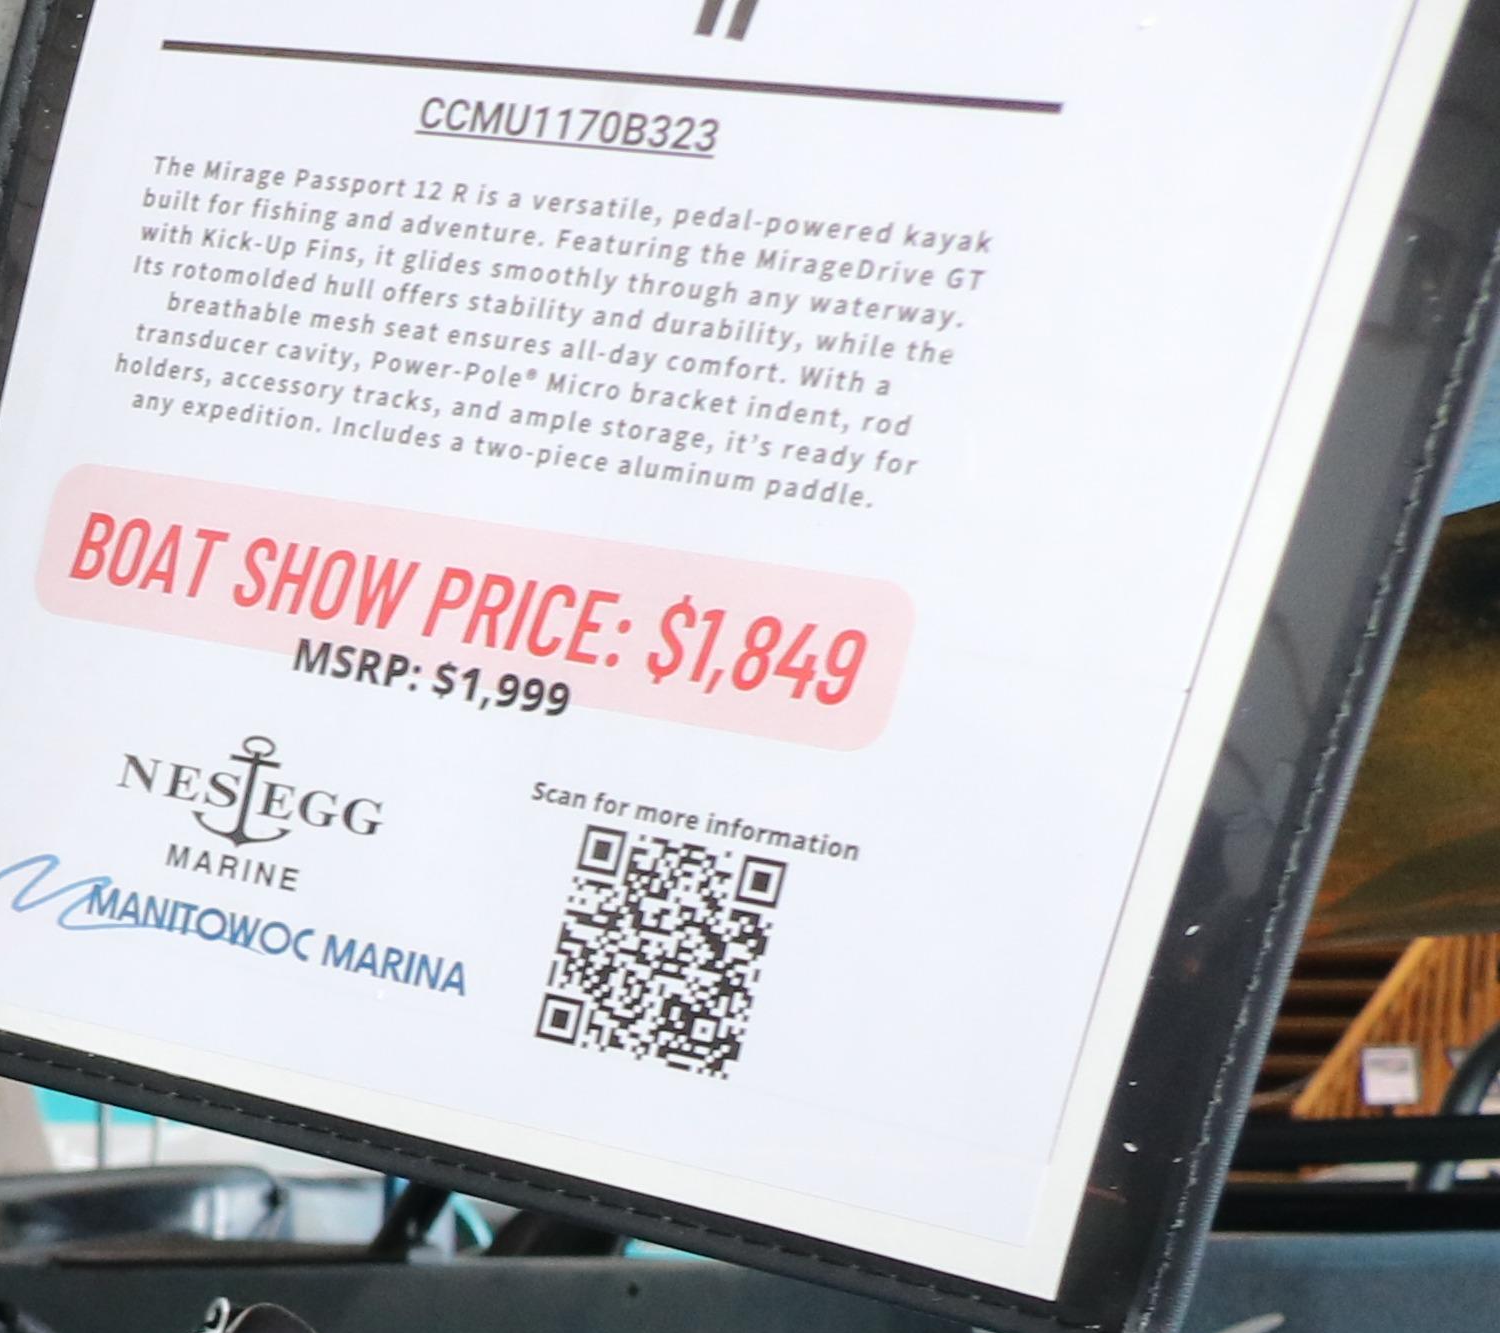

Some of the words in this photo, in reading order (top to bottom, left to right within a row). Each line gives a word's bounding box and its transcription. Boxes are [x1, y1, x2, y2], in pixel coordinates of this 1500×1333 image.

[413, 95, 720, 160] CCMU1170B323
[141, 186, 200, 212] built
[207, 192, 244, 216] for
[251, 196, 338, 232] fishing
[345, 210, 393, 231] and
[400, 213, 544, 247] adventure.
[555, 228, 691, 268] Featuring
[700, 242, 746, 267] the
[754, 248, 934, 287] MirageDrive
[945, 266, 986, 290] GT
[154, 154, 195, 178] The
[202, 159, 286, 190] Mirage
[293, 167, 407, 198] Passport
[413, 179, 443, 201] 12
[451, 182, 469, 203] R
[476, 183, 498, 207] is
[507, 191, 522, 208] a
[532, 194, 662, 227] versatile,
[671, 205, 894, 244] pedal-powered
[902, 223, 992, 255] kayak
[132, 254, 164, 276] Its
[171, 262, 317, 293] rotomolded
[323, 273, 375, 300] hull
[381, 281, 458, 309] offers
[466, 293, 583, 328] stability
[591, 308, 644, 330] and
[651, 310, 802, 353] durability,
[815, 331, 895, 359] while
[906, 339, 953, 366] the
[140, 222, 193, 245] with
[200, 227, 297, 260] Kick-Up
[305, 237, 364, 268] Fins,
[374, 244, 395, 267] it
[400, 248, 481, 276] glides
[489, 261, 618, 296] smoothly
[627, 272, 738, 308] through
[747, 288, 799, 315] any
[810, 296, 963, 332] waterway.
[135, 322, 269, 355] transducer
[275, 342, 360, 372] cavity,
[545, 371, 620, 401] Micro
[629, 380, 737, 415] bracket
[746, 394, 849, 433] indent,
[861, 414, 912, 437] rod
[166, 290, 301, 326] breathable
[308, 312, 375, 334] mesh
[383, 320, 439, 342] seat
[446, 328, 551, 356] ensures
[560, 338, 658, 374] all-day
[665, 354, 785, 384] comfort.
[799, 365, 864, 393] With
[874, 378, 891, 396] a
[114, 351, 211, 388] holders,
[220, 370, 344, 405] accessory
[352, 384, 440, 418] tracks,
[450, 399, 501, 421] and
[508, 407, 592, 434] ample
[600, 418, 713, 454] storage,
[781, 443, 865, 474] ready
[874, 448, 918, 475] for
[131, 392, 174, 417] any
[181, 399, 321, 433] expedition.
[332, 415, 441, 449] Includes
[449, 435, 464, 452] a
[474, 435, 608, 472] two-piece
[616, 454, 755, 491] aluminum
[763, 478, 872, 508] paddle.
[67, 510, 231, 598] BOAT
[231, 536, 422, 630] SHOW
[420, 565, 632, 668] PRICE:
[644, 593, 868, 706] $1,849
[291, 636, 423, 692] MSRP:
[430, 660, 572, 717] $1,999
[164, 842, 300, 892] MARINE
[530, 780, 587, 809] Scan
[592, 790, 631, 817] for
[633, 803, 700, 831] more
[704, 811, 860, 862] information
[84, 882, 318, 963] MANITOWOC
[320, 932, 466, 997] MARINA
